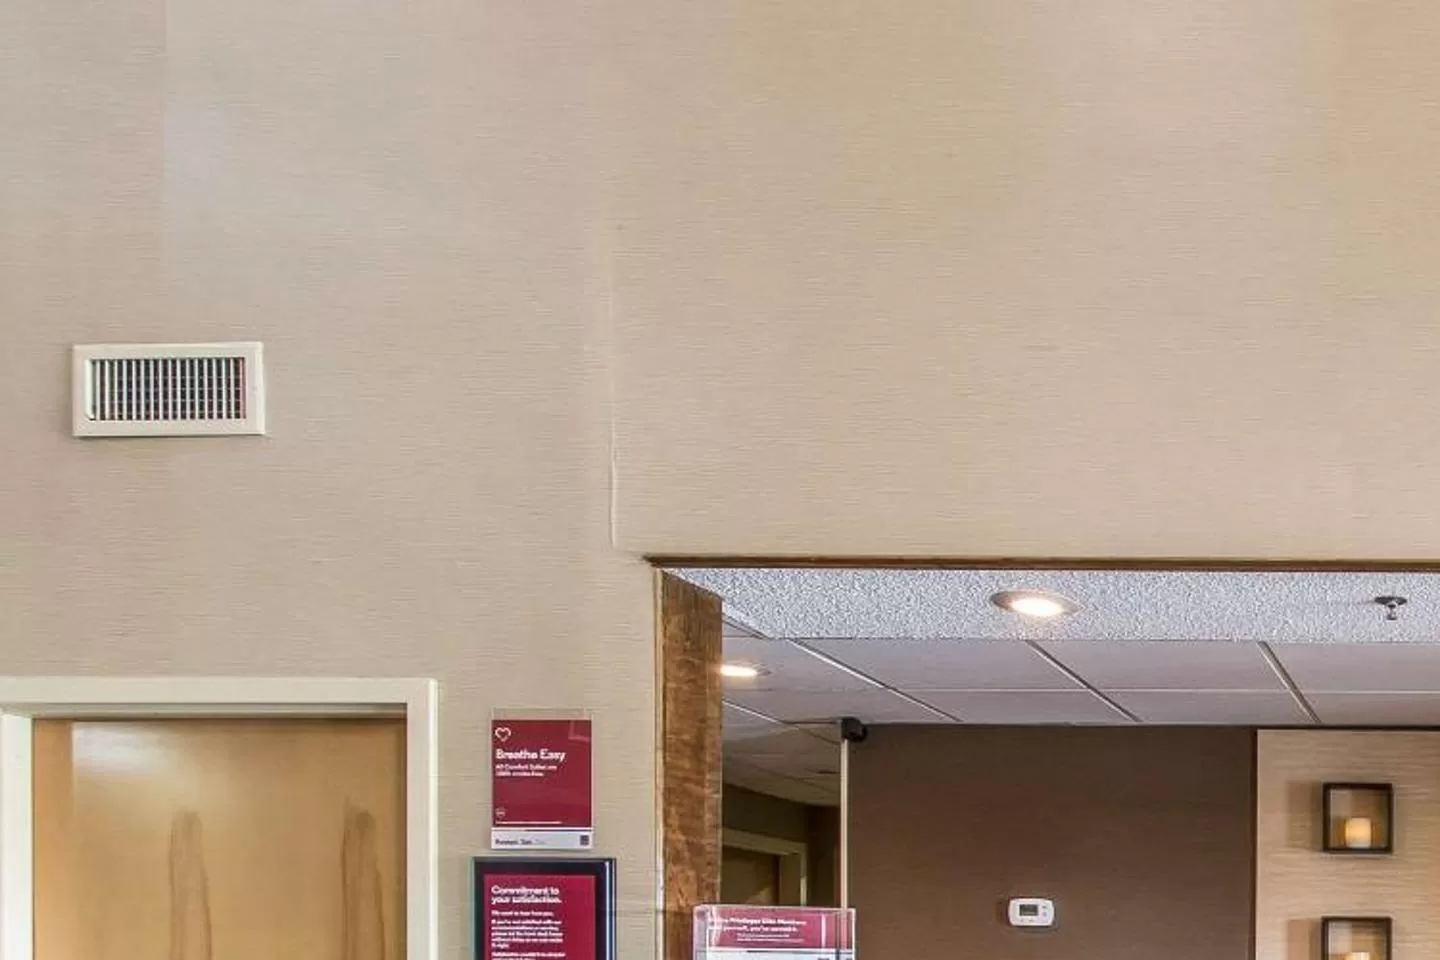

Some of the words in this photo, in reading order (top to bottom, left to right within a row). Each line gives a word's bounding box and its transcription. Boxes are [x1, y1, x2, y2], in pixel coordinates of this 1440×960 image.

[496, 748, 538, 759] Breathe
[540, 748, 566, 762] Easy
[550, 886, 560, 895] to
